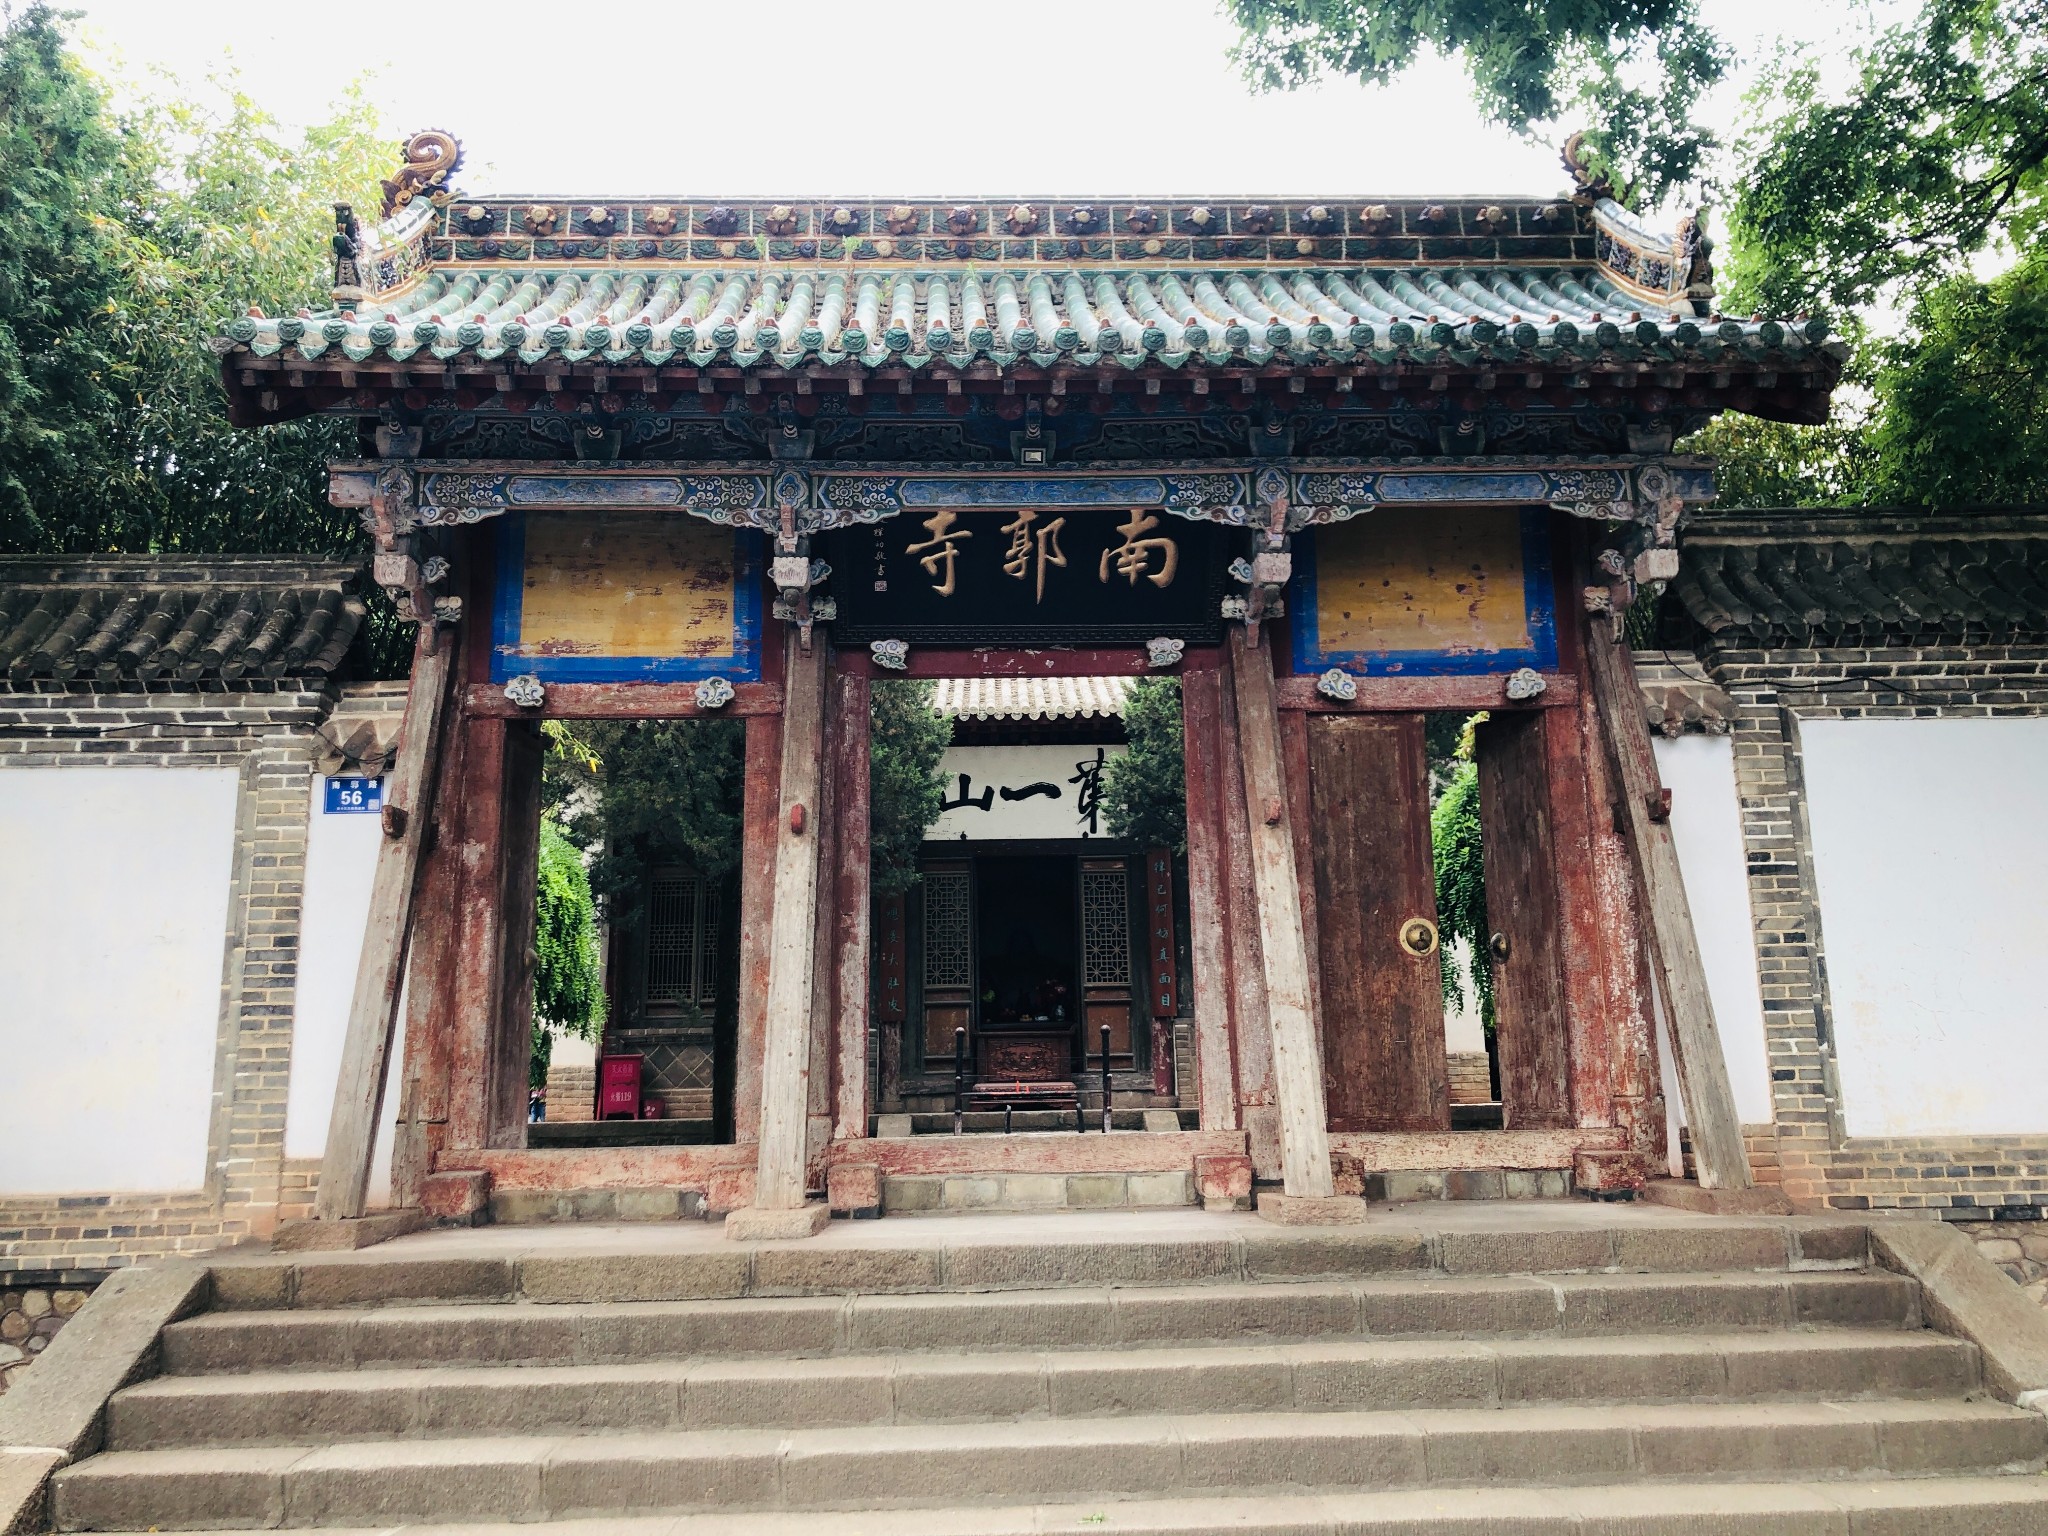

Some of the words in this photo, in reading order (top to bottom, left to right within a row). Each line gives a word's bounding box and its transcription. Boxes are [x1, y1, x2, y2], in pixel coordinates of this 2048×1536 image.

[905, 509, 1179, 605] 南郭寺
[340, 790, 363, 805] 56
